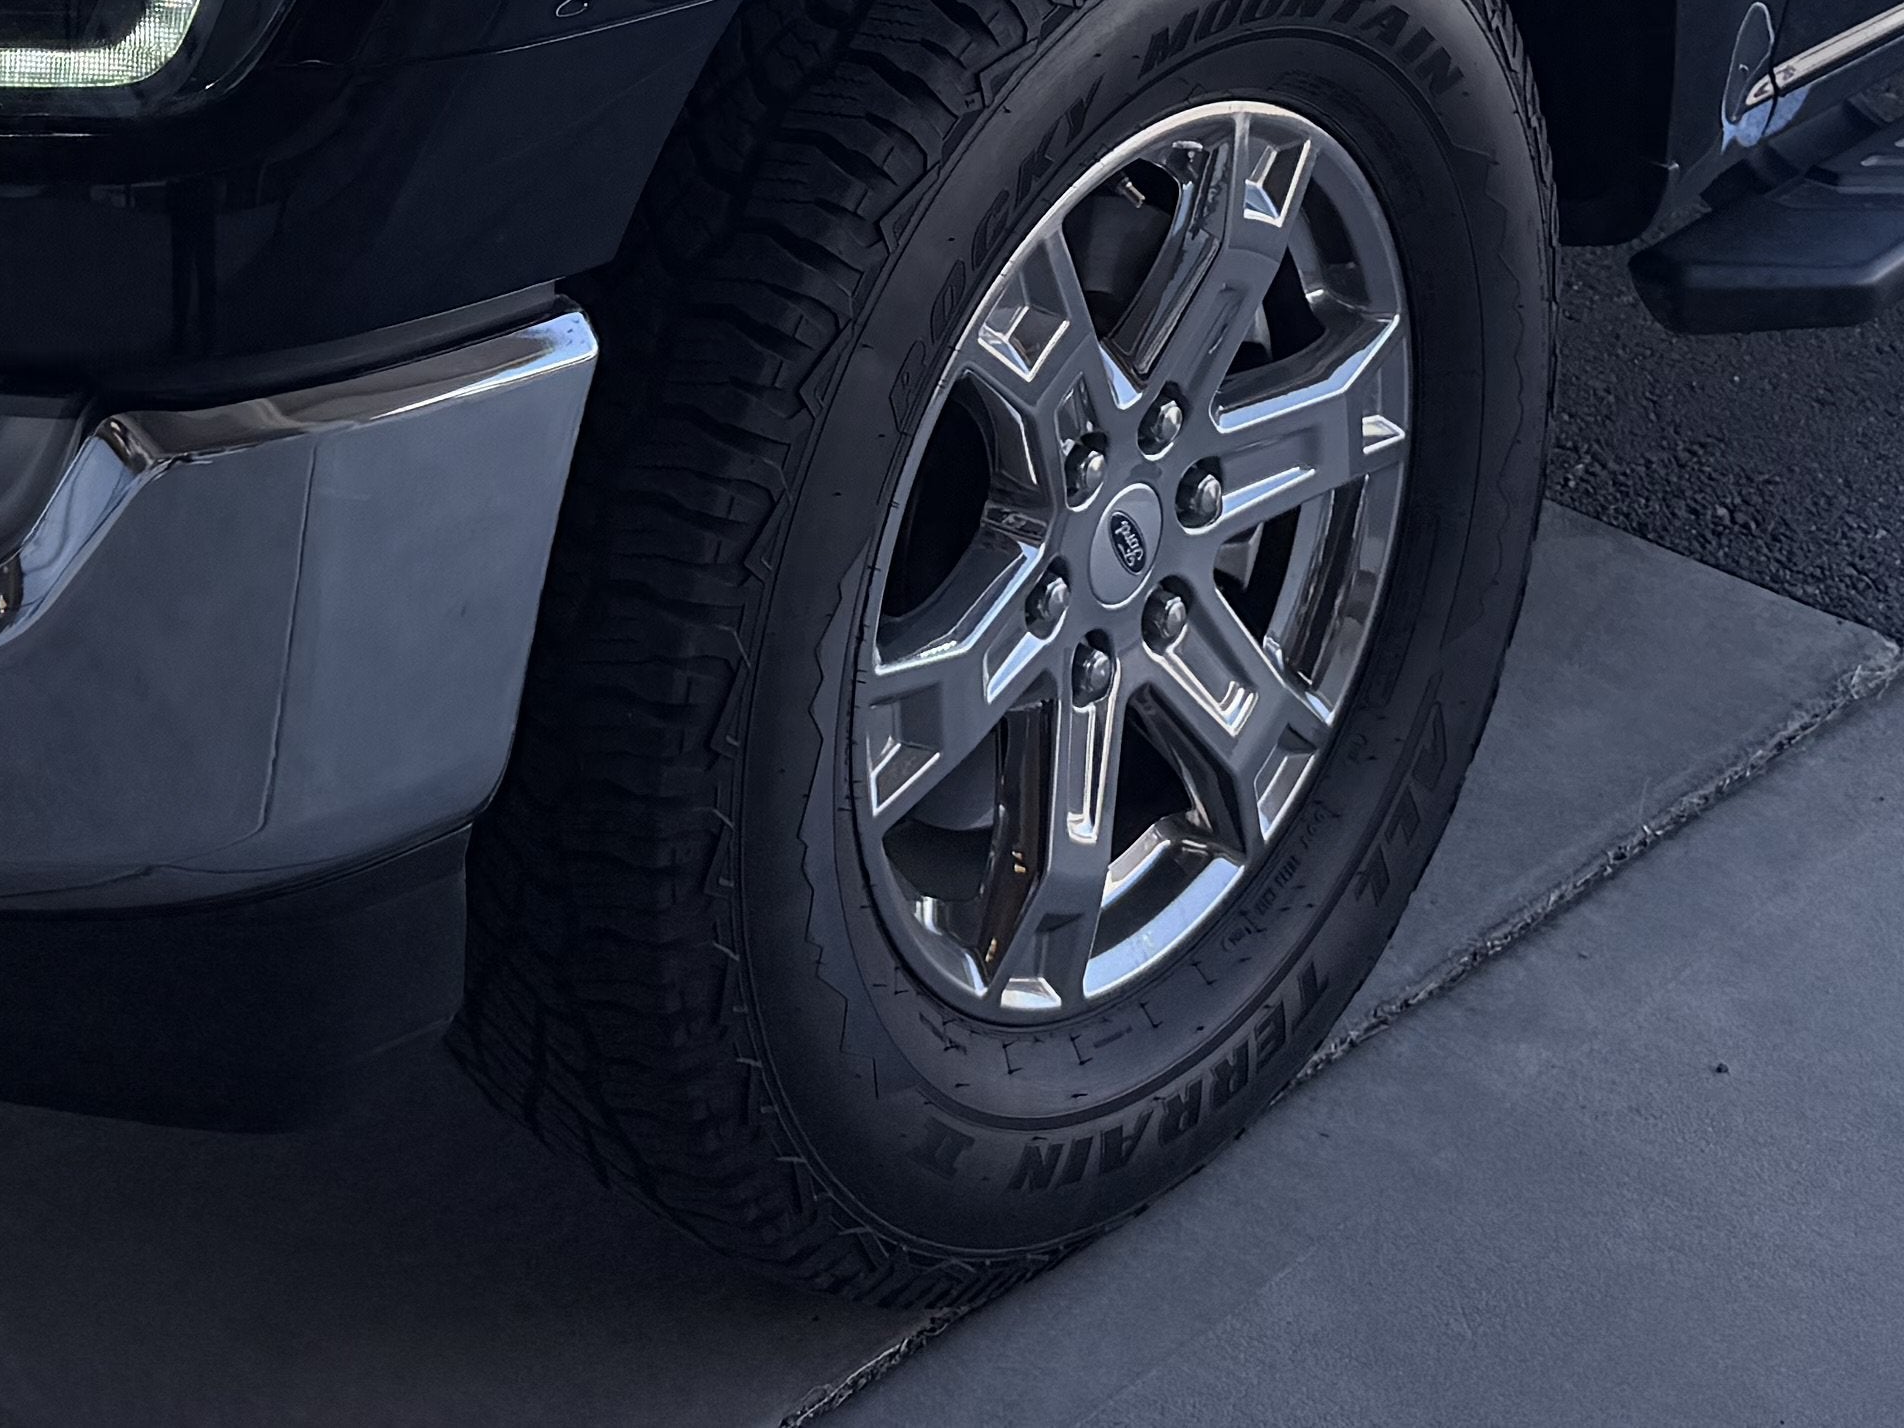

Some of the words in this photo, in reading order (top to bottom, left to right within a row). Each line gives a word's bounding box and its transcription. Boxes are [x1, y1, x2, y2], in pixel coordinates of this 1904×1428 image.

[889, 75, 1104, 434] ROCKY
[1115, 520, 1144, 566] Ford
[1006, 959, 1330, 1191] TERRAIN
